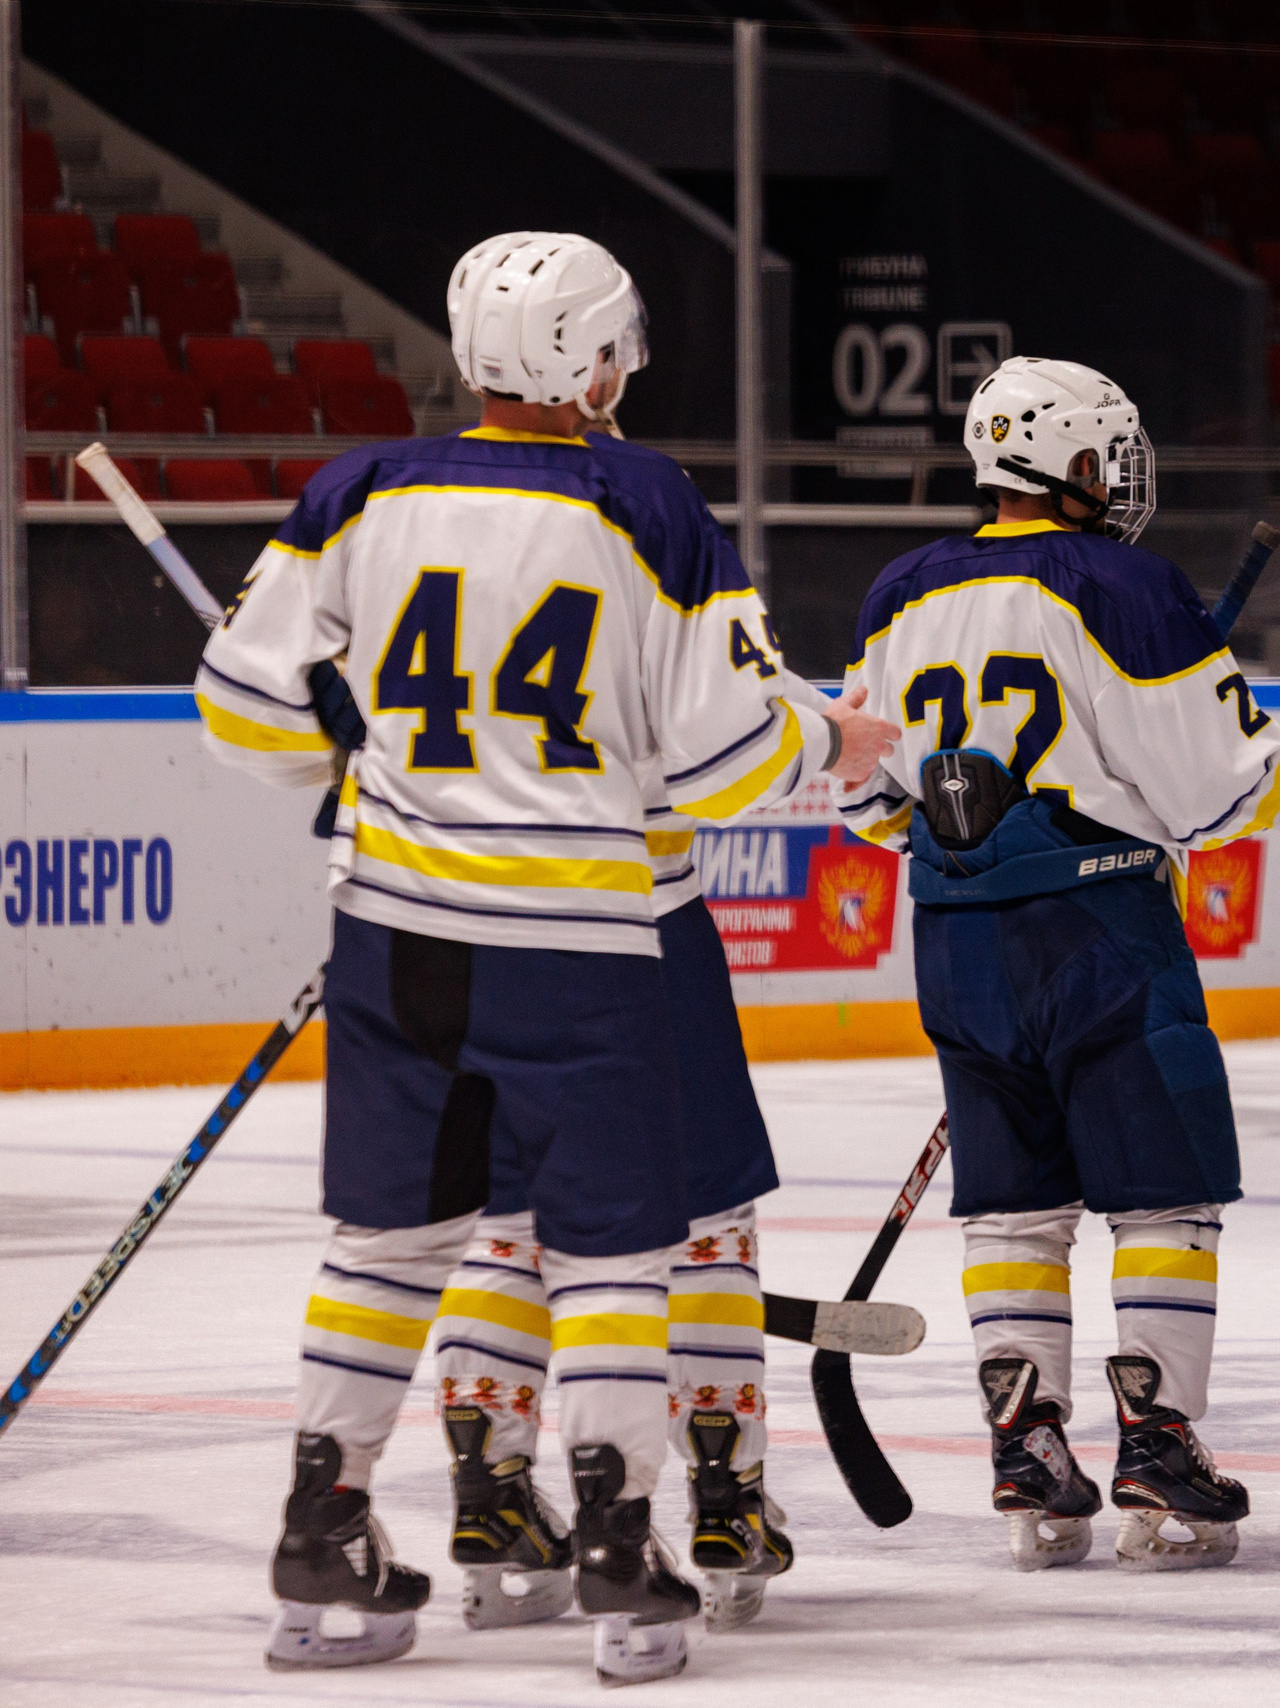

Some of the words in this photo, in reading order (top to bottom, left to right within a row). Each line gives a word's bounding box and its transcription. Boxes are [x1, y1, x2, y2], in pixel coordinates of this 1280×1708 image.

[834, 324, 930, 416] 02
[371, 565, 605, 774] 44
[0, 838, 173, 927] ЭНЕРГО
[692, 831, 788, 897] ИНА
